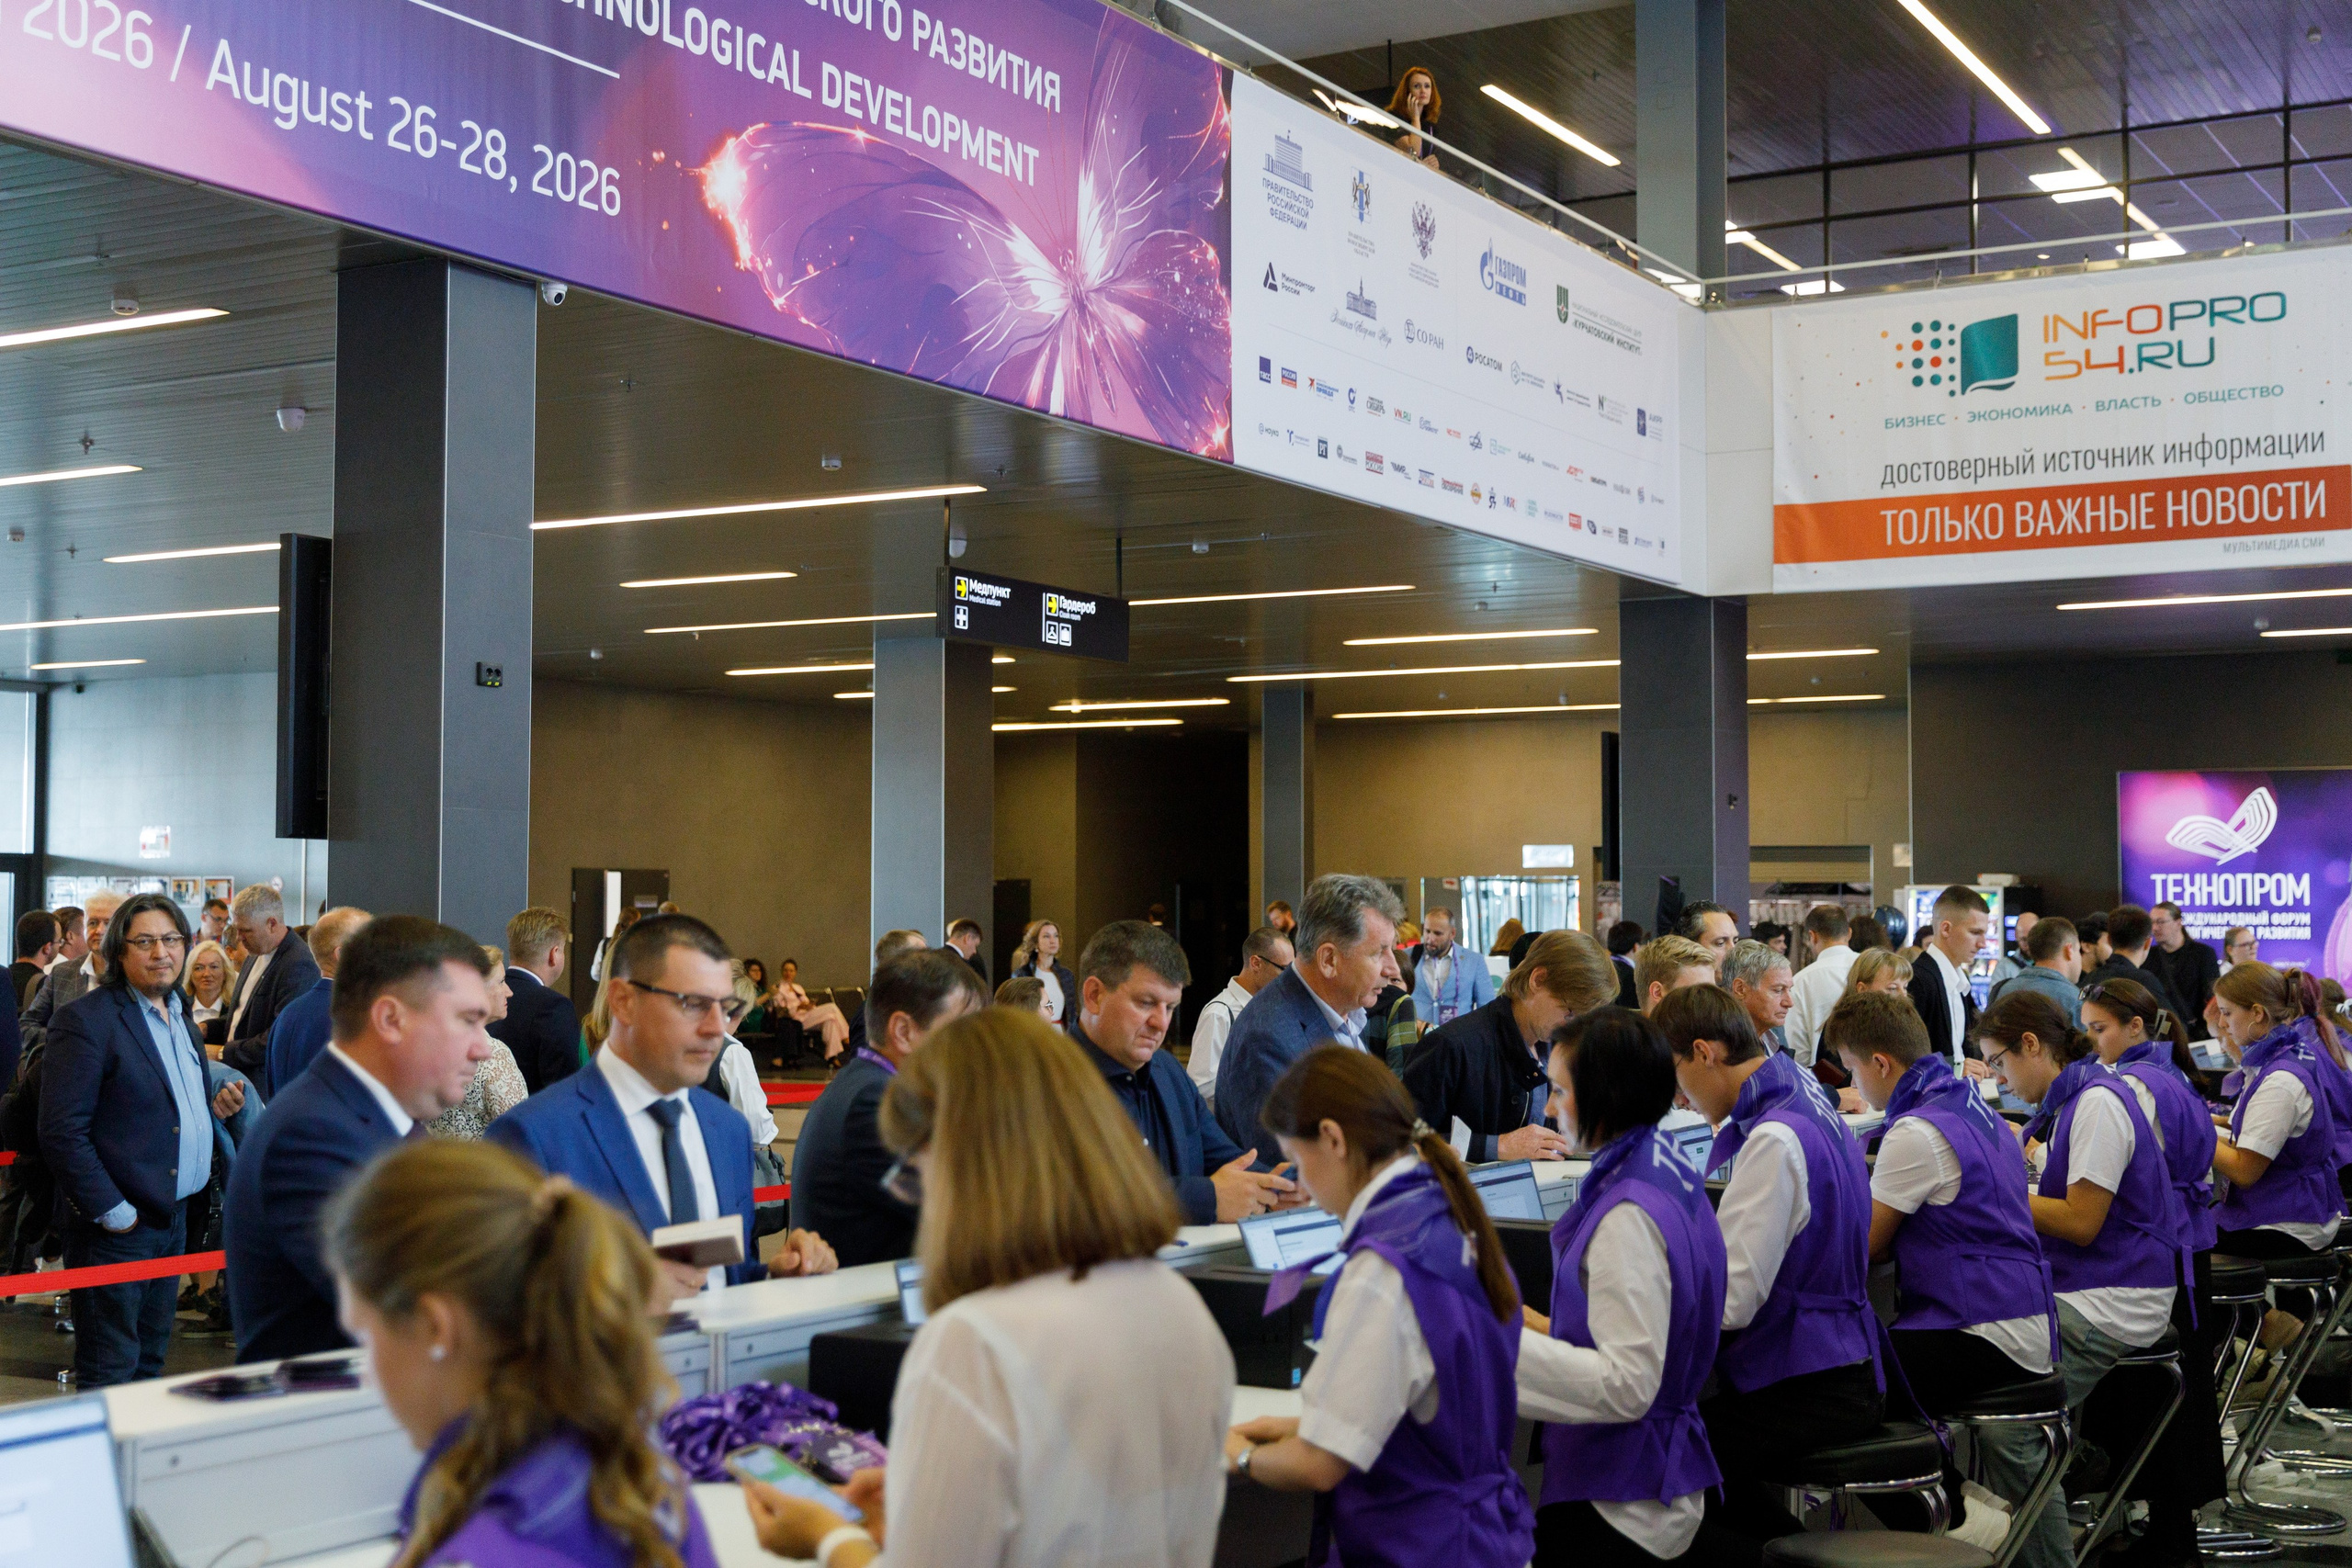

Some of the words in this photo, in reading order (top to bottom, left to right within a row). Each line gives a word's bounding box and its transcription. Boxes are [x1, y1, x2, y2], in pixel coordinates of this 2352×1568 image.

[913, 9, 1060, 113] РАЗВИТИЯ
[23, 0, 153, 69] 2026
[170, 24, 191, 82] /
[206, 39, 373, 141] August
[388, 96, 516, 194] 26-28,
[532, 144, 621, 216] 2026
[821, 62, 1039, 186] DEVELOPMENT
[1262, 177, 1314, 209] ПРАВИТЕЛЬСТВО
[1267, 192, 1310, 220] РОССИЙСКОЙ
[1269, 207, 1307, 231] ФЕДЕРАЦИИ
[1282, 272, 1316, 293] Минпромторг
[1495, 255, 1527, 288] ГАЗПРОМ
[1281, 283, 1301, 296] России
[1496, 283, 1526, 306] НЕФТЬ
[2042, 290, 2287, 344] INFOPRO
[1417, 328, 1428, 344] СО
[1429, 333, 1444, 350] РАН
[1475, 352, 1503, 372] РОСАТОМ
[2044, 336, 2216, 381] 54.RU
[1366, 400, 1385, 414] СИБИРЬ
[1394, 408, 1411, 422] VN.RU
[1883, 412, 1947, 429] БИЗНЕС
[1967, 401, 2074, 423] ЭКОНОМИКА
[2095, 394, 2162, 412] ВЛАСТЬ
[2183, 383, 2285, 405] ОБЩЕСТВО
[1880, 443, 2036, 490] достоверный
[2042, 439, 2155, 473] источник
[2163, 428, 2326, 466] информации
[1880, 502, 2005, 546] ТОЛЬКО
[2015, 491, 2155, 537] ВАЖНЫЕ
[2166, 479, 2327, 526] НОВОСТИ
[2222, 539, 2301, 554] МУЛЬТИМЕДИА
[2302, 537, 2325, 549] СМИ
[968, 593, 987, 605] Medical
[986, 597, 1002, 607] station
[969, 579, 1012, 599] Медпункт
[1059, 595, 1097, 615] Гардероб
[2150, 873, 2312, 907] ТЕХНОПРОМ
[2270, 912, 2311, 926] ФОРУМ
[2256, 926, 2312, 941] РАЗВИТИЯ
